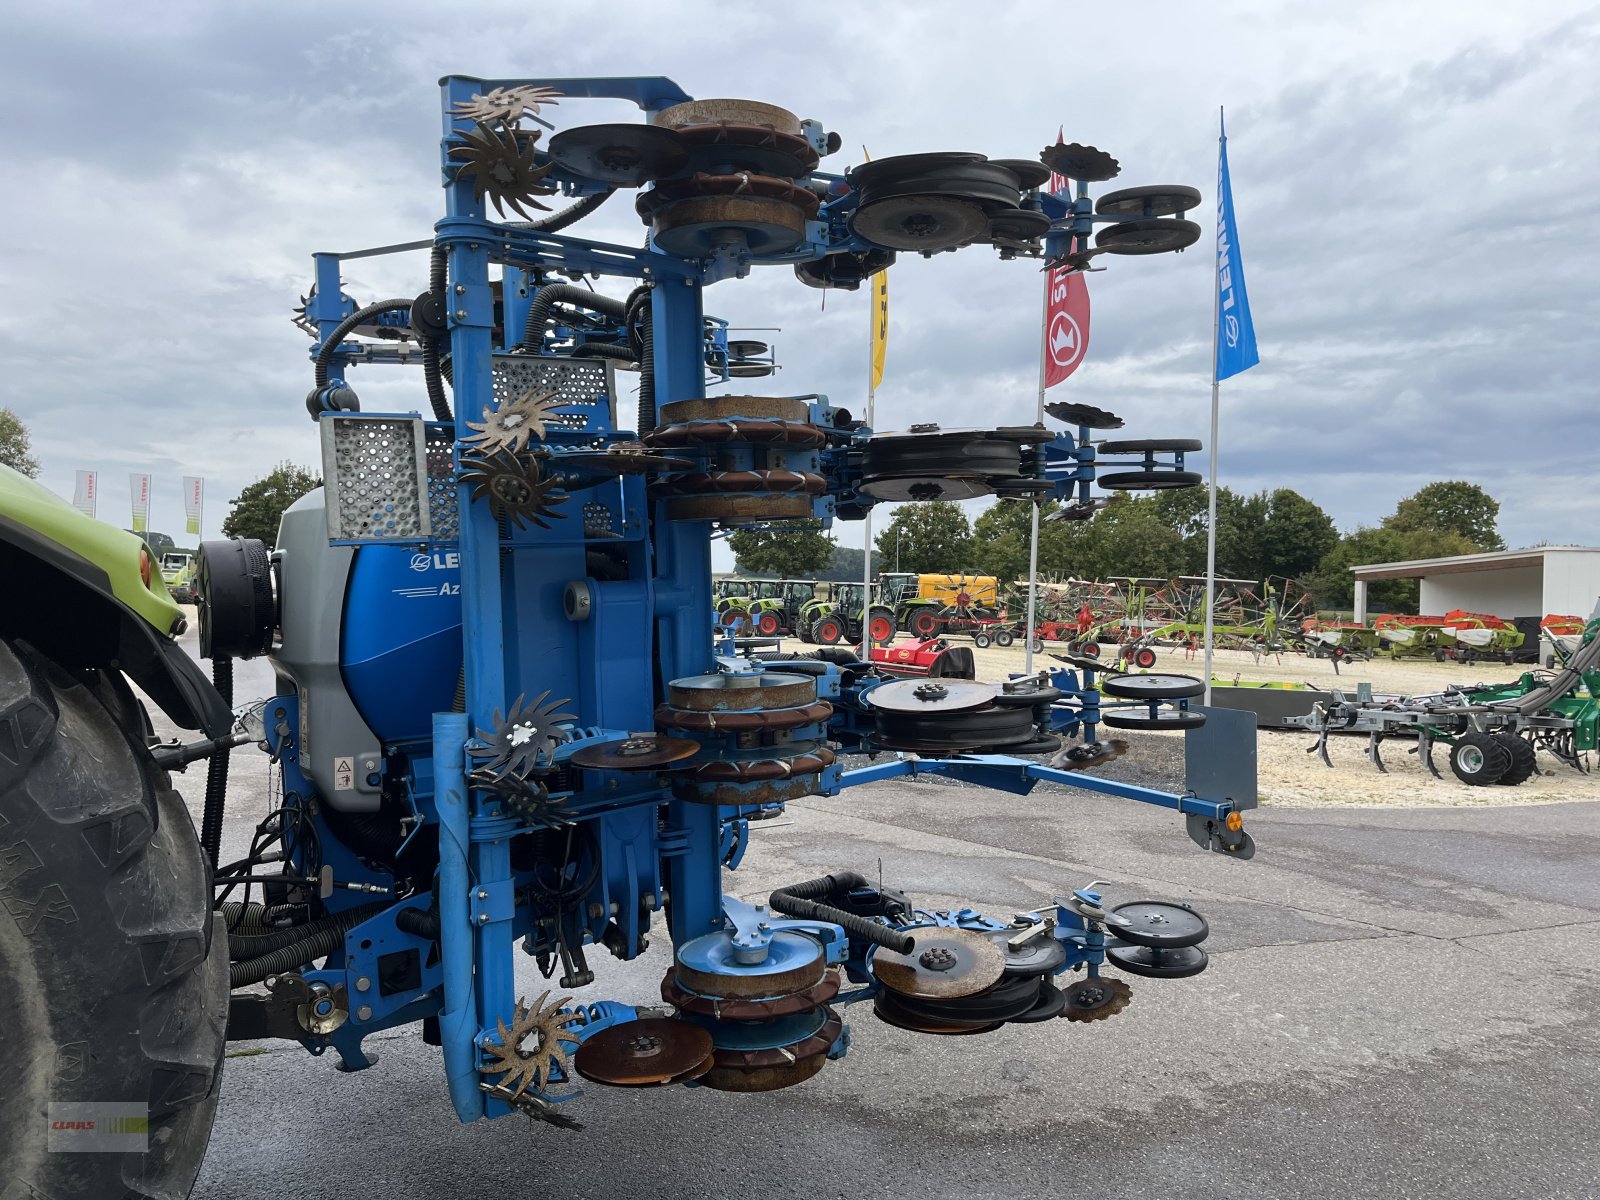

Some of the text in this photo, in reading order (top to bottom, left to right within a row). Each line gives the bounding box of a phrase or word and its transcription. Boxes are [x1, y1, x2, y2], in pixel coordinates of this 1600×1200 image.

[433, 552, 461, 569] LE
[439, 582, 462, 596] Az
[0, 812, 80, 937] AX
